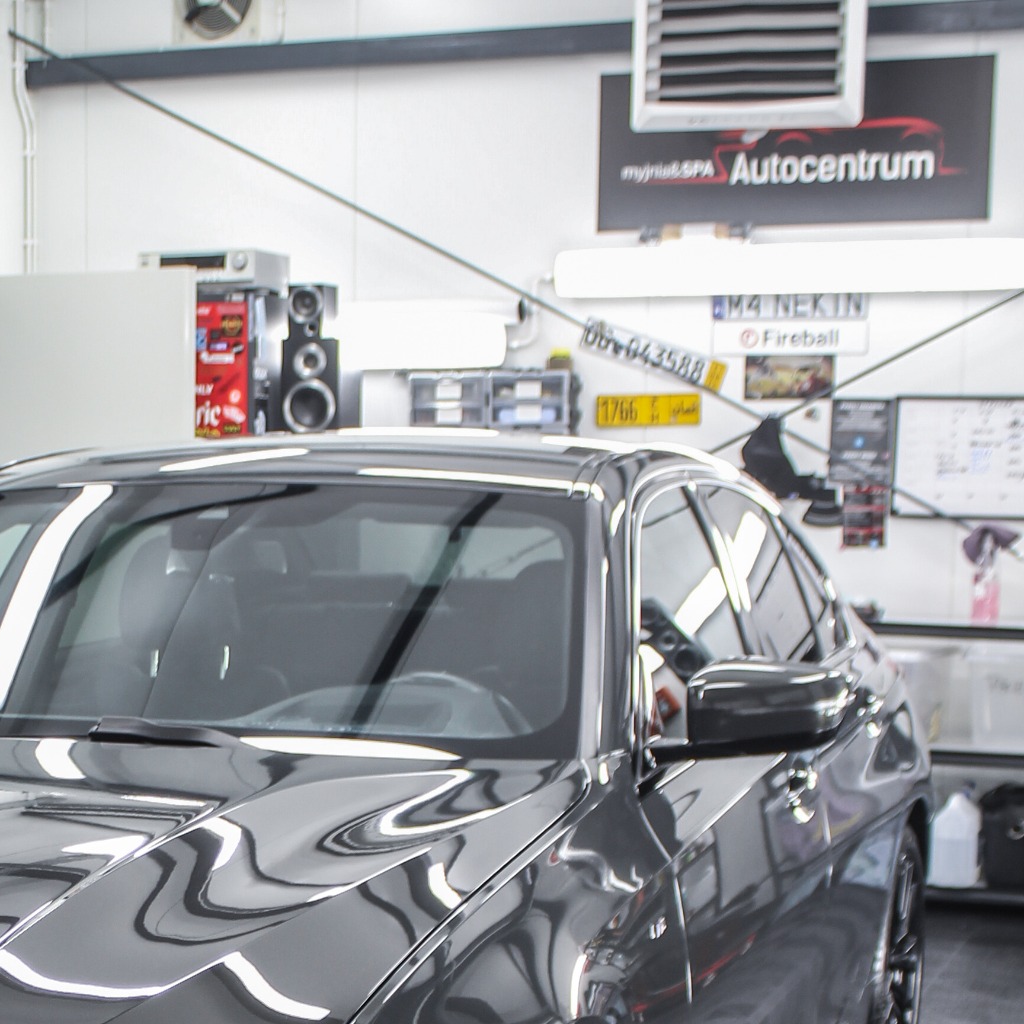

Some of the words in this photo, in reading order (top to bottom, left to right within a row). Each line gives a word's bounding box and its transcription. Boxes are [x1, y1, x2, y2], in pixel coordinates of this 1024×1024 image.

[729, 150, 935, 186] Autocentrum
[762, 328, 840, 347] Fireball
[598, 398, 639, 423] 1766
